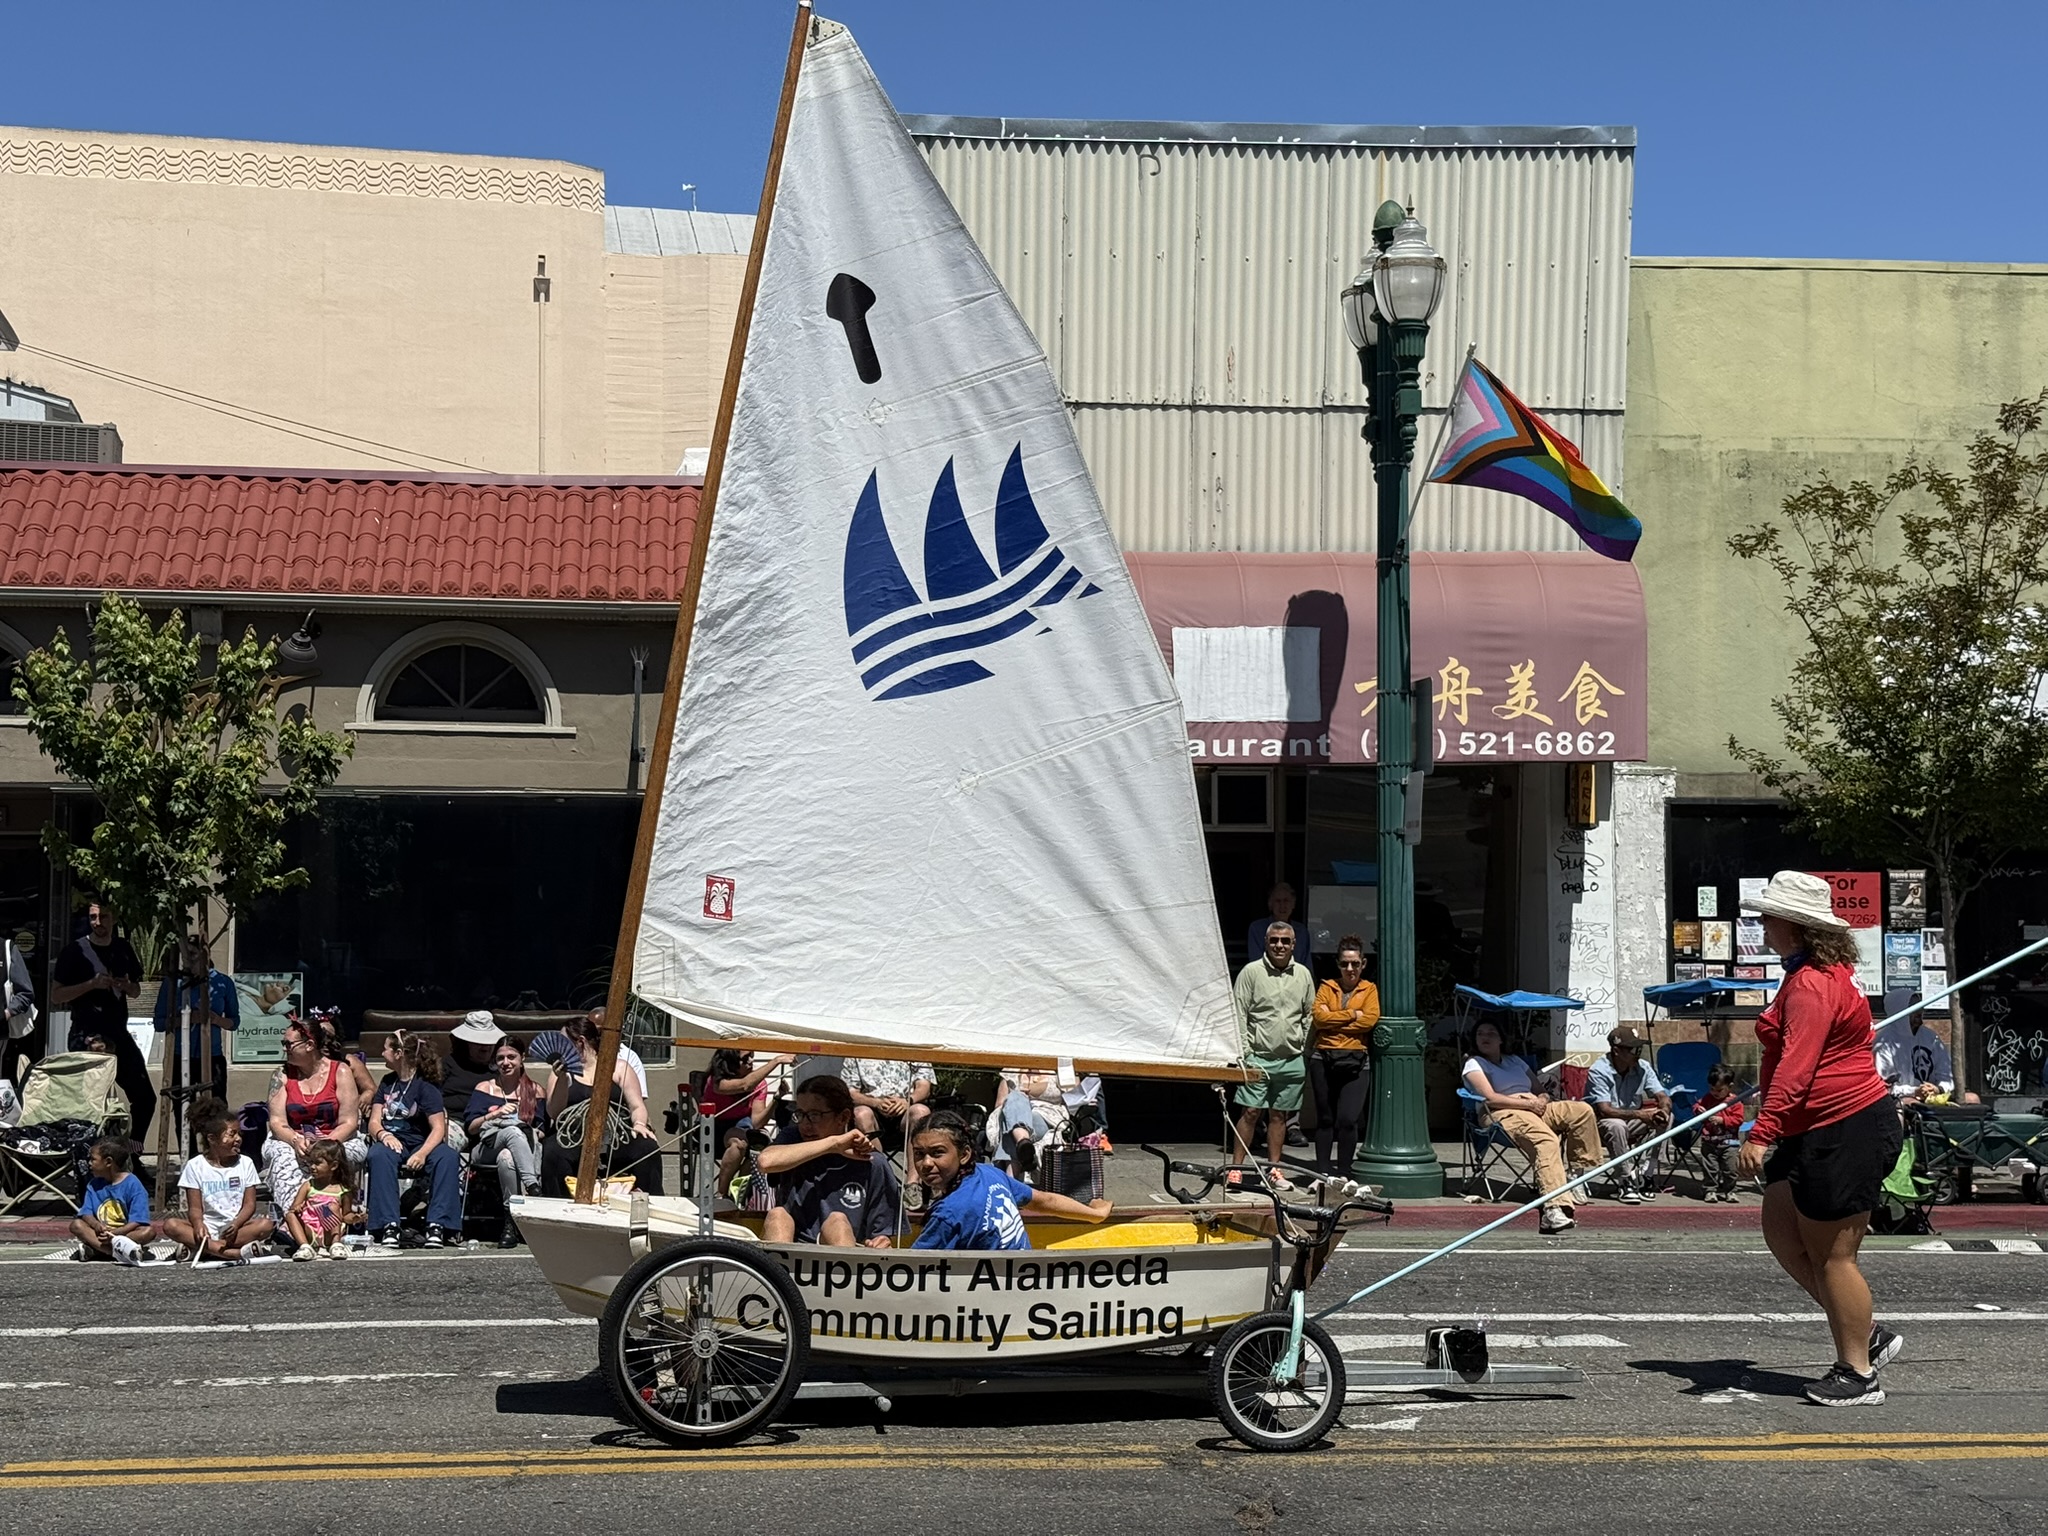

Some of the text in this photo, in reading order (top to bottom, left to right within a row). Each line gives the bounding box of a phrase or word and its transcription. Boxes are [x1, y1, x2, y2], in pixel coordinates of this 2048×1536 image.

[1458, 731, 1616, 756] 521-6862
[1824, 875, 1858, 890] For
[967, 1254, 1170, 1292] Alameda
[1027, 1300, 1185, 1338] Sailing
